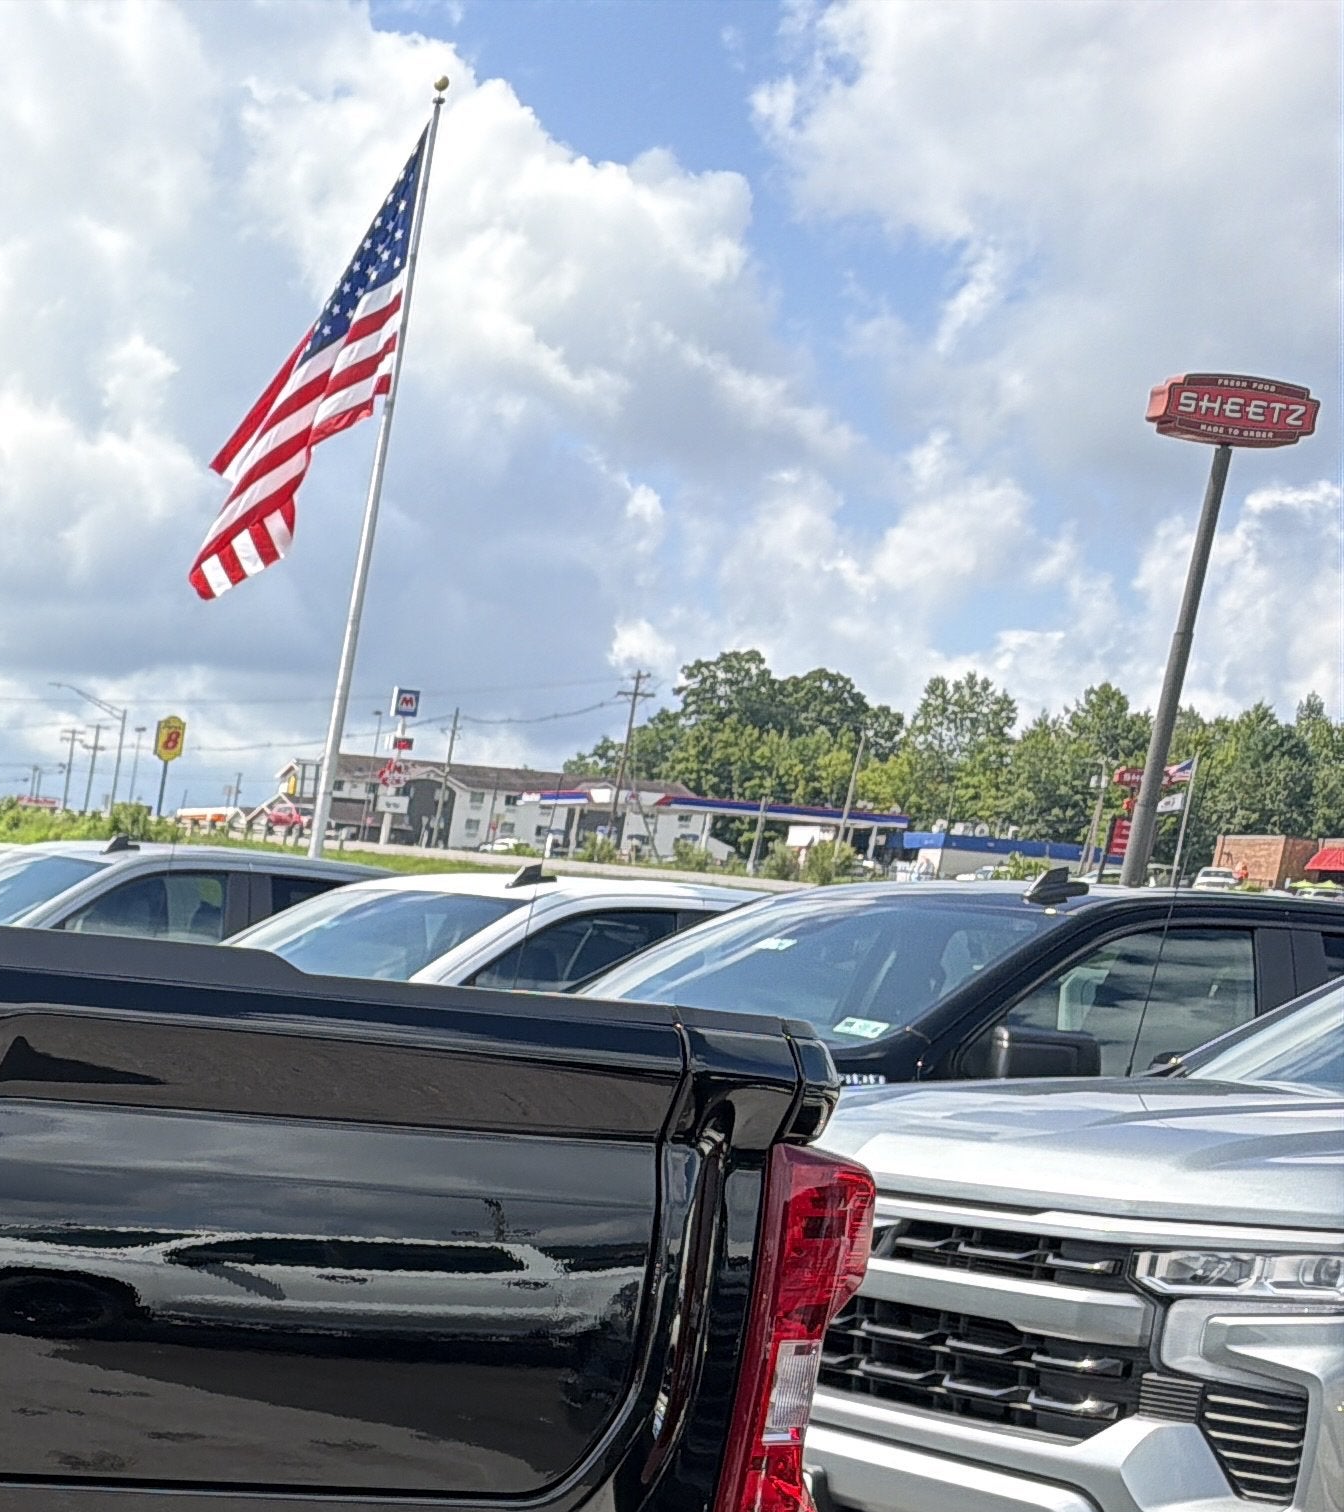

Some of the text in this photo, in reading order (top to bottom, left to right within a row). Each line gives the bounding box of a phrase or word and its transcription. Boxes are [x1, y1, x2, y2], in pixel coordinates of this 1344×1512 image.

[1177, 391, 1308, 427] SHEETZ
[1228, 427, 1240, 436] TO
[162, 729, 181, 751] 8
